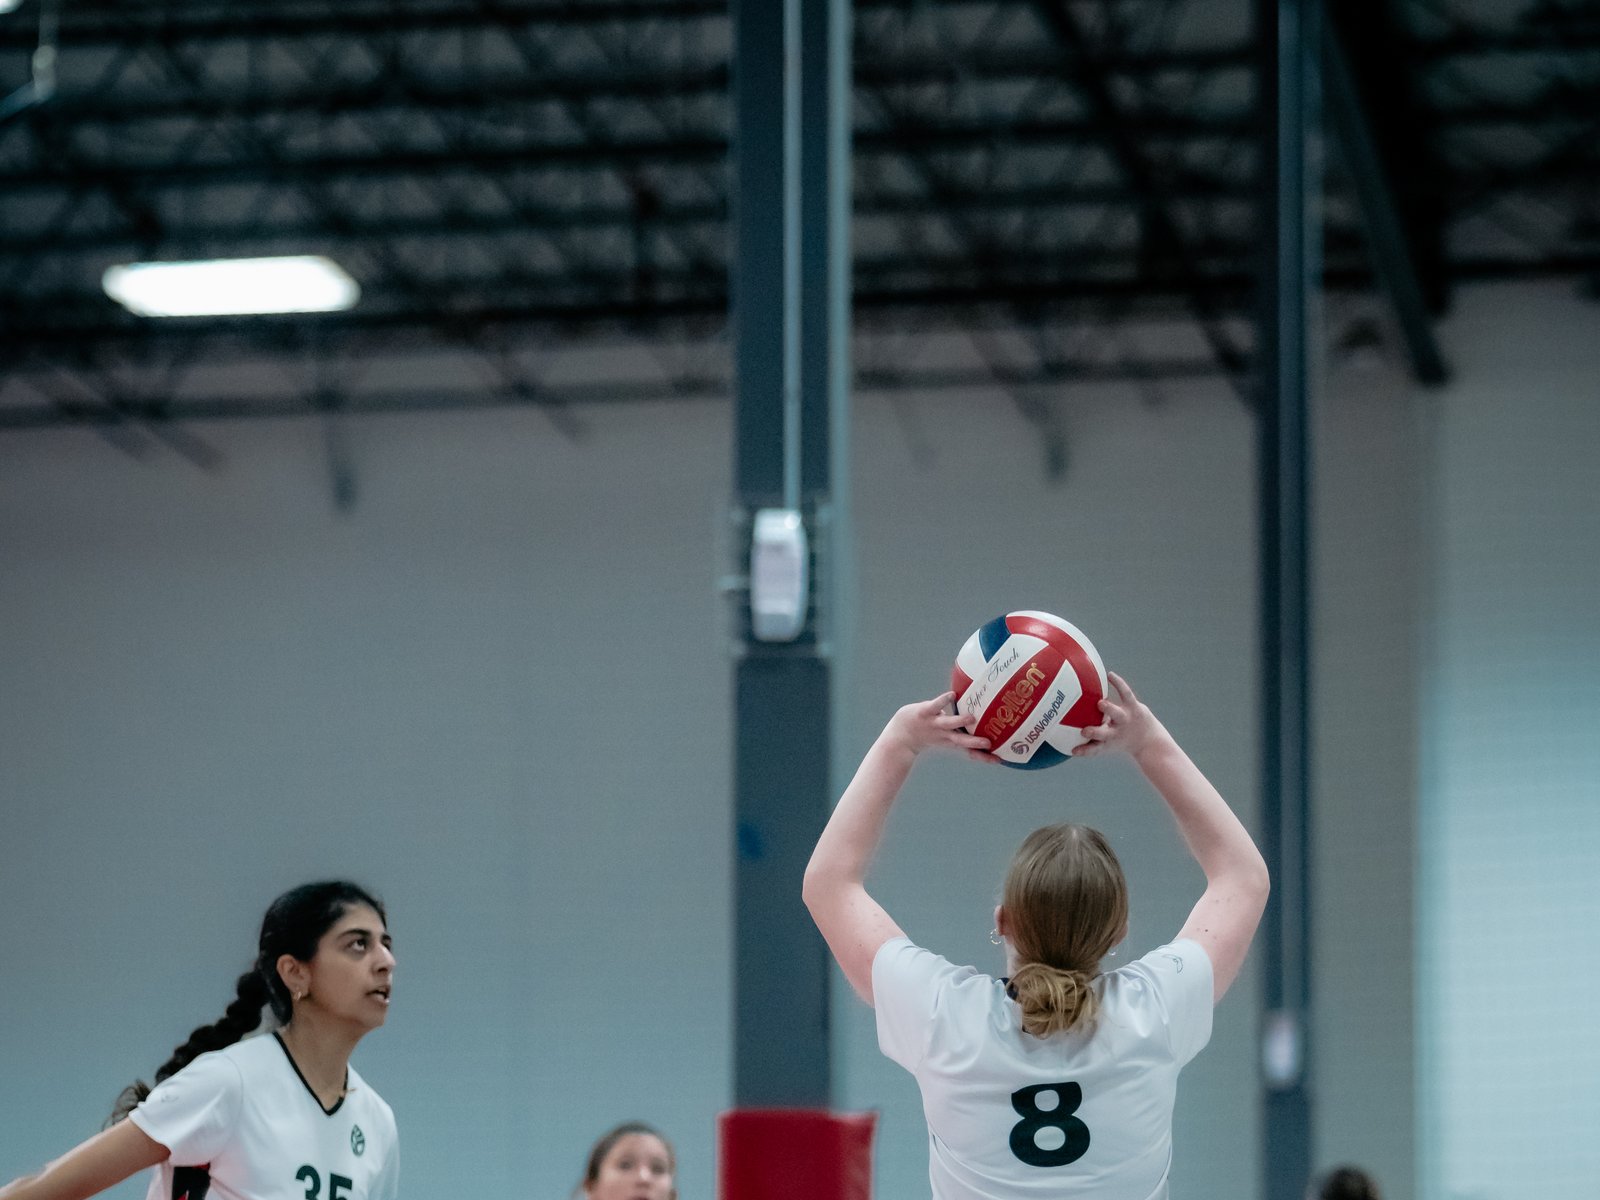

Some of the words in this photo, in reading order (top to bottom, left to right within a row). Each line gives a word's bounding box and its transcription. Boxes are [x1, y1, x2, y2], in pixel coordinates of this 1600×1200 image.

[988, 648, 1019, 682] Touch
[984, 666, 1046, 740] molten
[1009, 1081, 1091, 1167] 8
